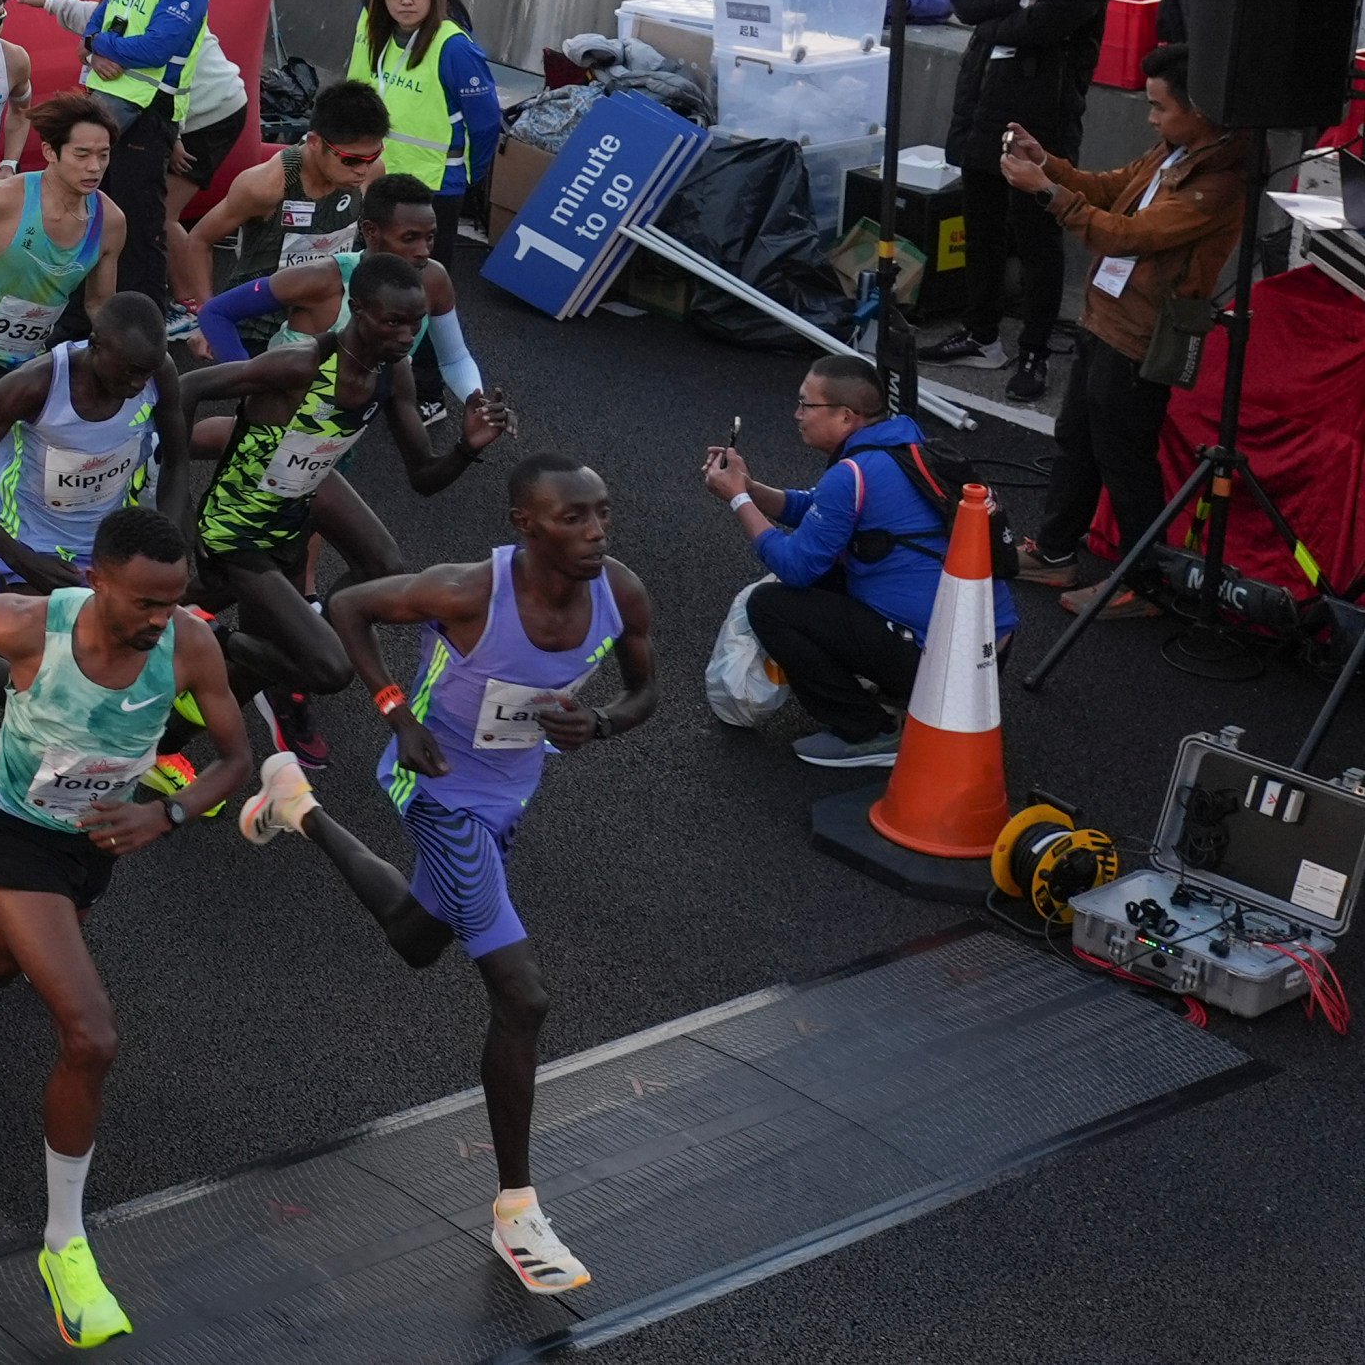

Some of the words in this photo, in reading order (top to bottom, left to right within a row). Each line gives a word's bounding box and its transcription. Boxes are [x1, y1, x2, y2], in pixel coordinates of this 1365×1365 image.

[550, 133, 621, 227] minute
[574, 208, 606, 242] to
[600, 171, 635, 214] go
[513, 223, 586, 272] 1
[58, 457, 131, 488] Kiprop
